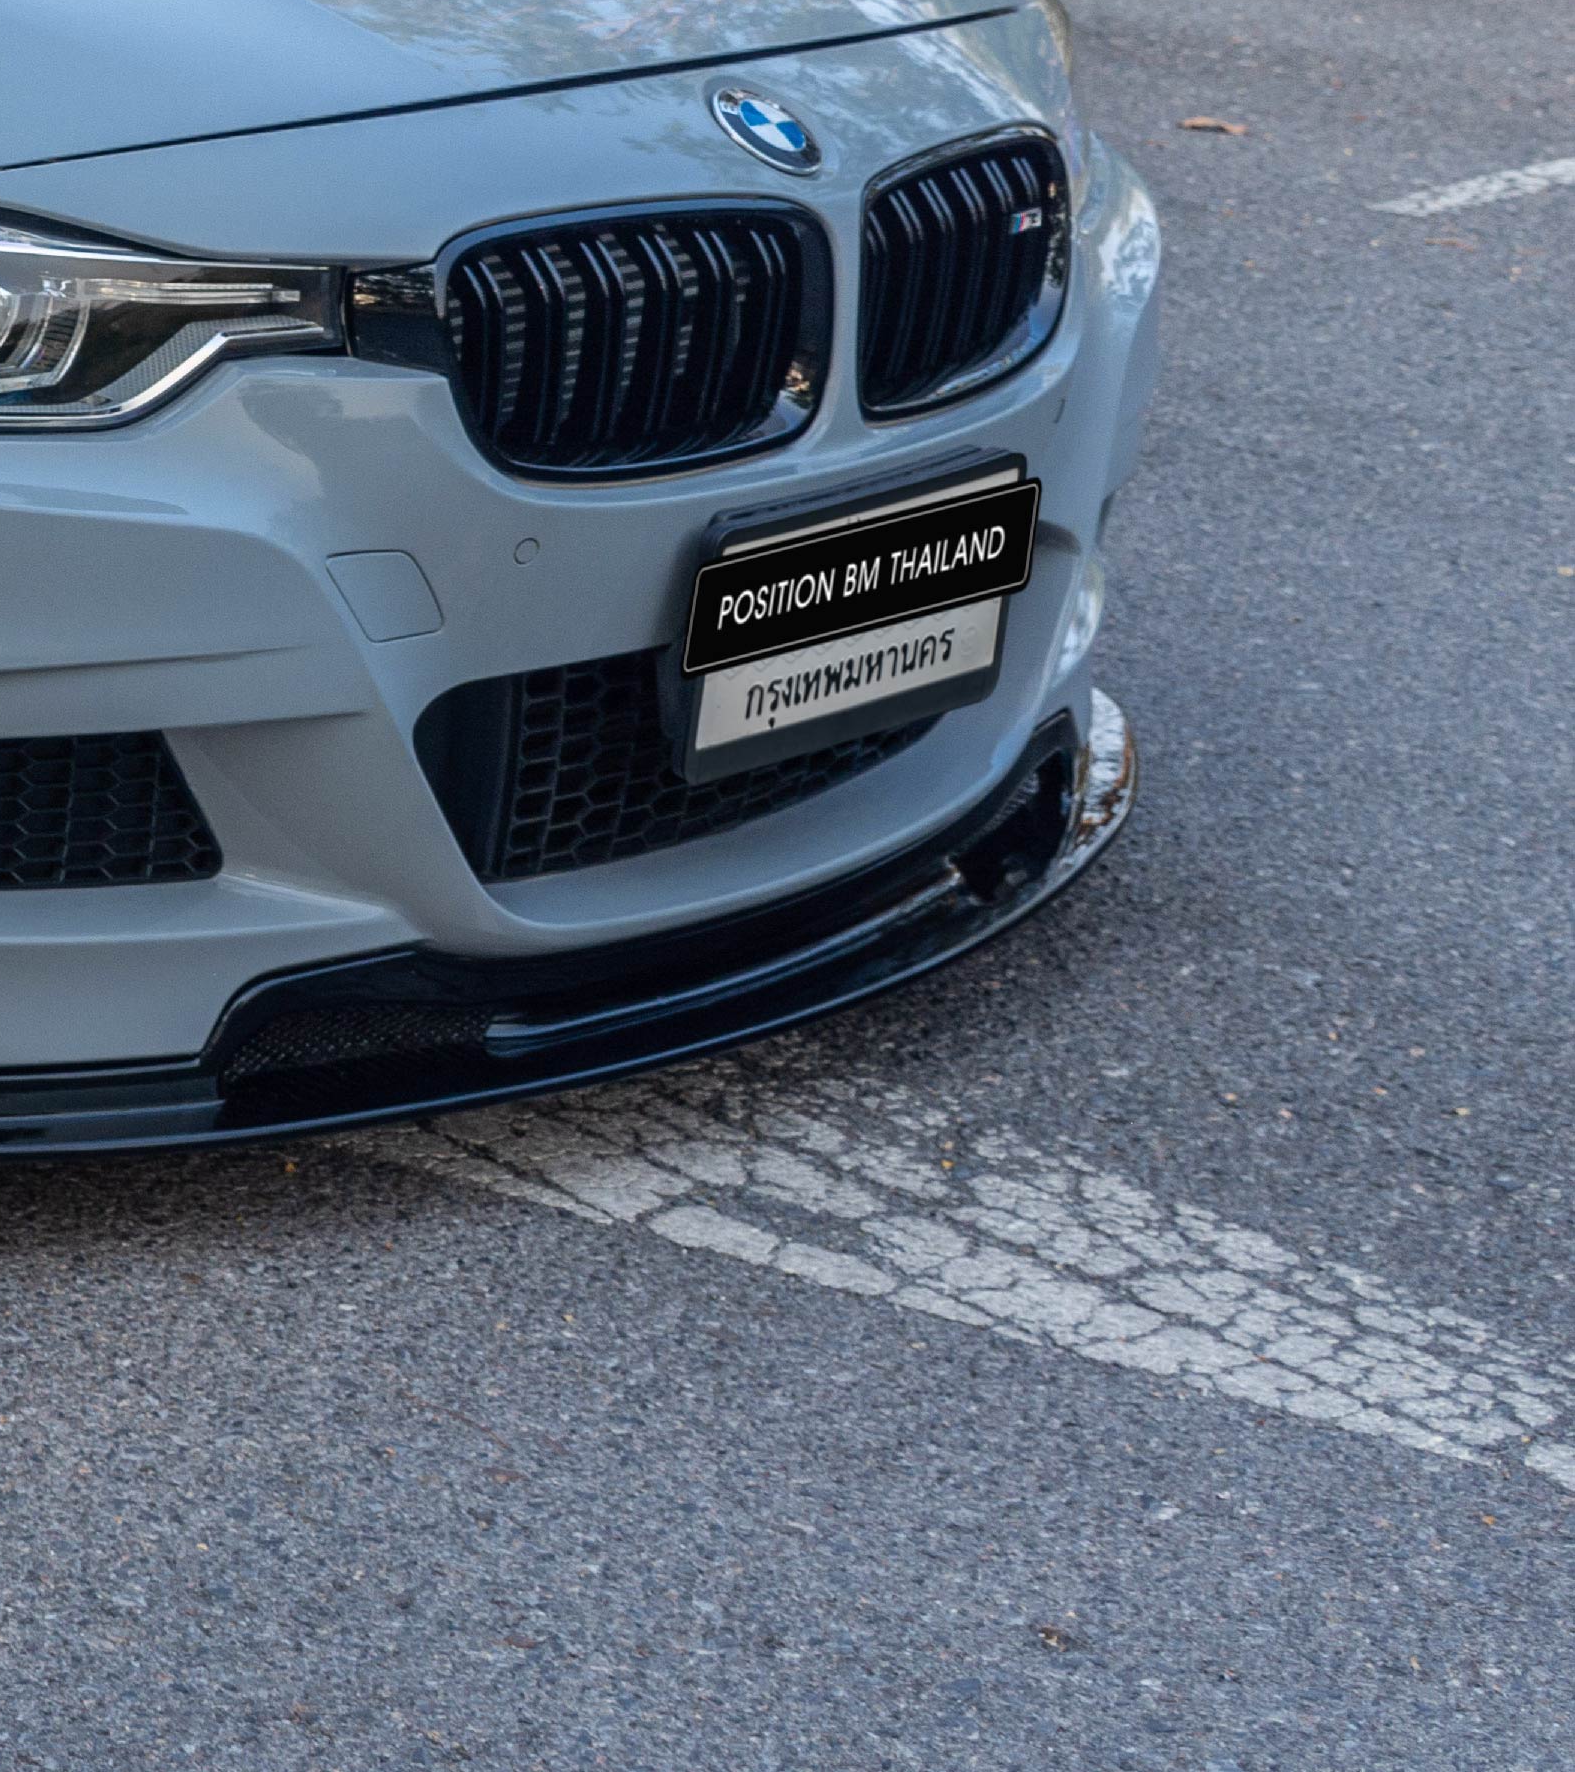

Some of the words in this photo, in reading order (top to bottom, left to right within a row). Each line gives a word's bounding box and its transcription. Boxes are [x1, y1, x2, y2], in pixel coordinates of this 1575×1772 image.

[745, 627, 955, 729] กรุงเทพมหานคร
